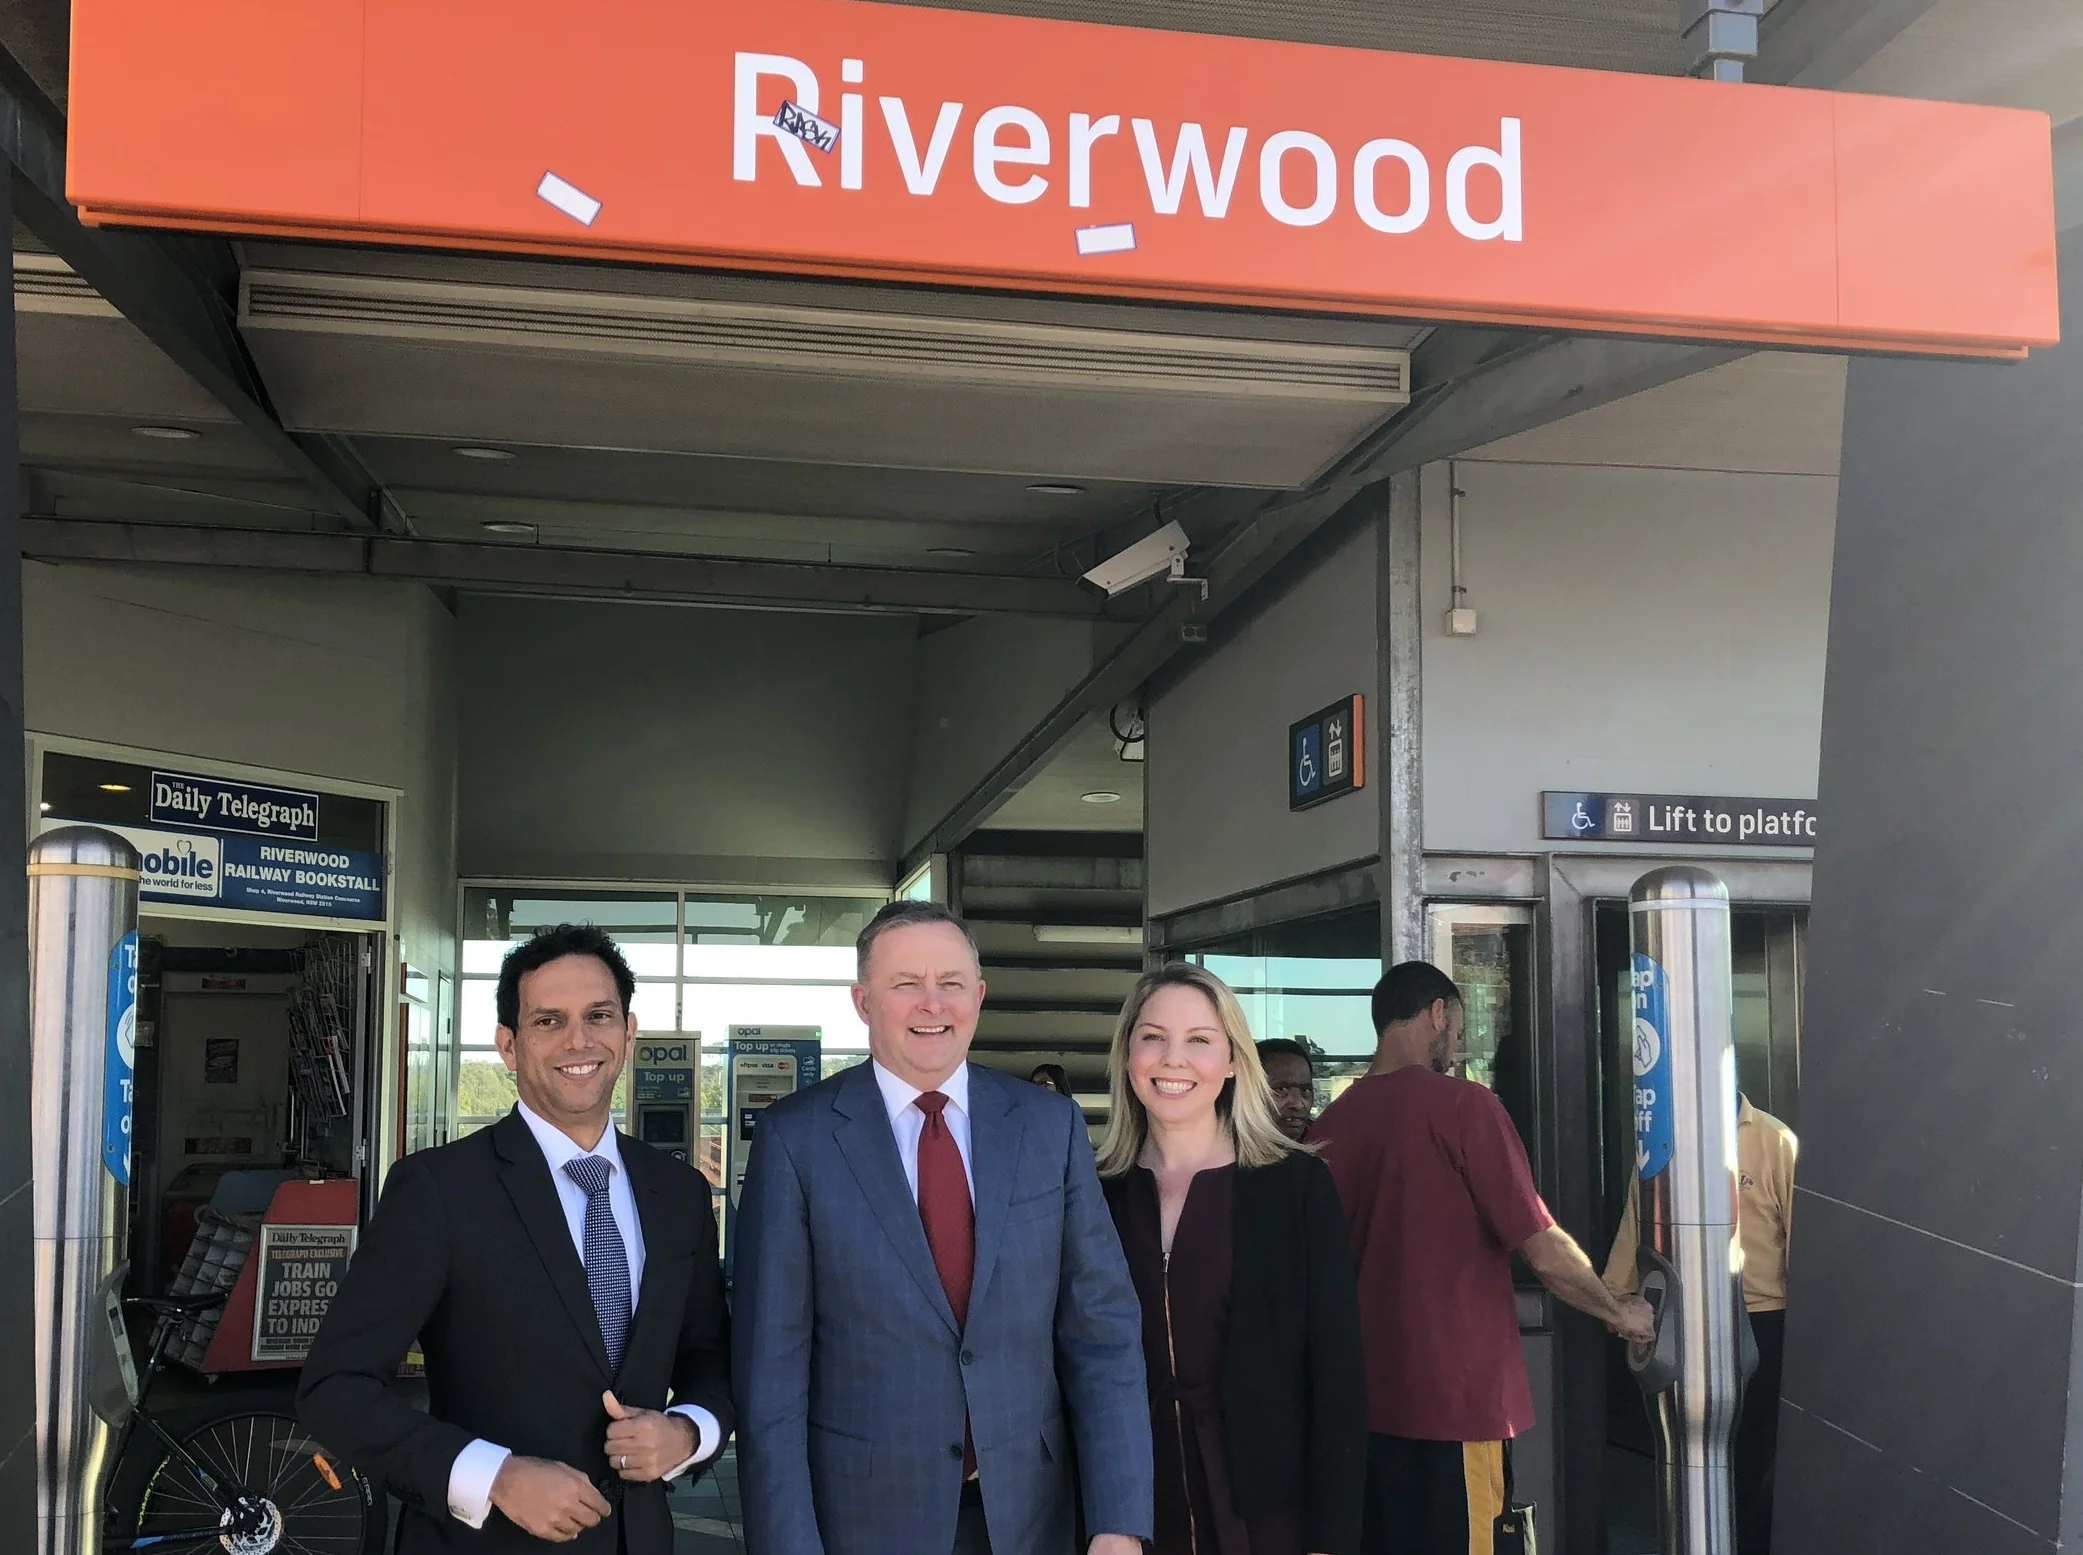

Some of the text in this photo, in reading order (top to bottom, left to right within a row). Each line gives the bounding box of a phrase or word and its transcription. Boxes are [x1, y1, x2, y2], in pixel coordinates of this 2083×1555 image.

[733, 52, 1522, 241] Riverwood
[155, 783, 315, 831] Daily Telegraph
[1650, 806, 1696, 831] Lift
[1704, 809, 1731, 833] to
[260, 846, 349, 869] RIVERWOOD
[152, 877, 179, 889] world
[181, 879, 194, 890] for
[195, 880, 213, 891] less
[225, 863, 380, 892] RAILWAY BOOKSTALL
[267, 888, 294, 897] Riverwood
[295, 891, 314, 899] Railway
[738, 1028, 761, 1037] opal
[639, 1043, 687, 1065] opal
[734, 1041, 769, 1053] Top up
[644, 1071, 685, 1084] Top up
[272, 1232, 345, 1244] Daily Telegraph
[271, 1248, 344, 1259] TELEGRAPH EXCLUSIVE
[282, 1262, 331, 1279] TRAIN
[272, 1281, 338, 1297] JOBS GO
[267, 1318, 288, 1334] TO
